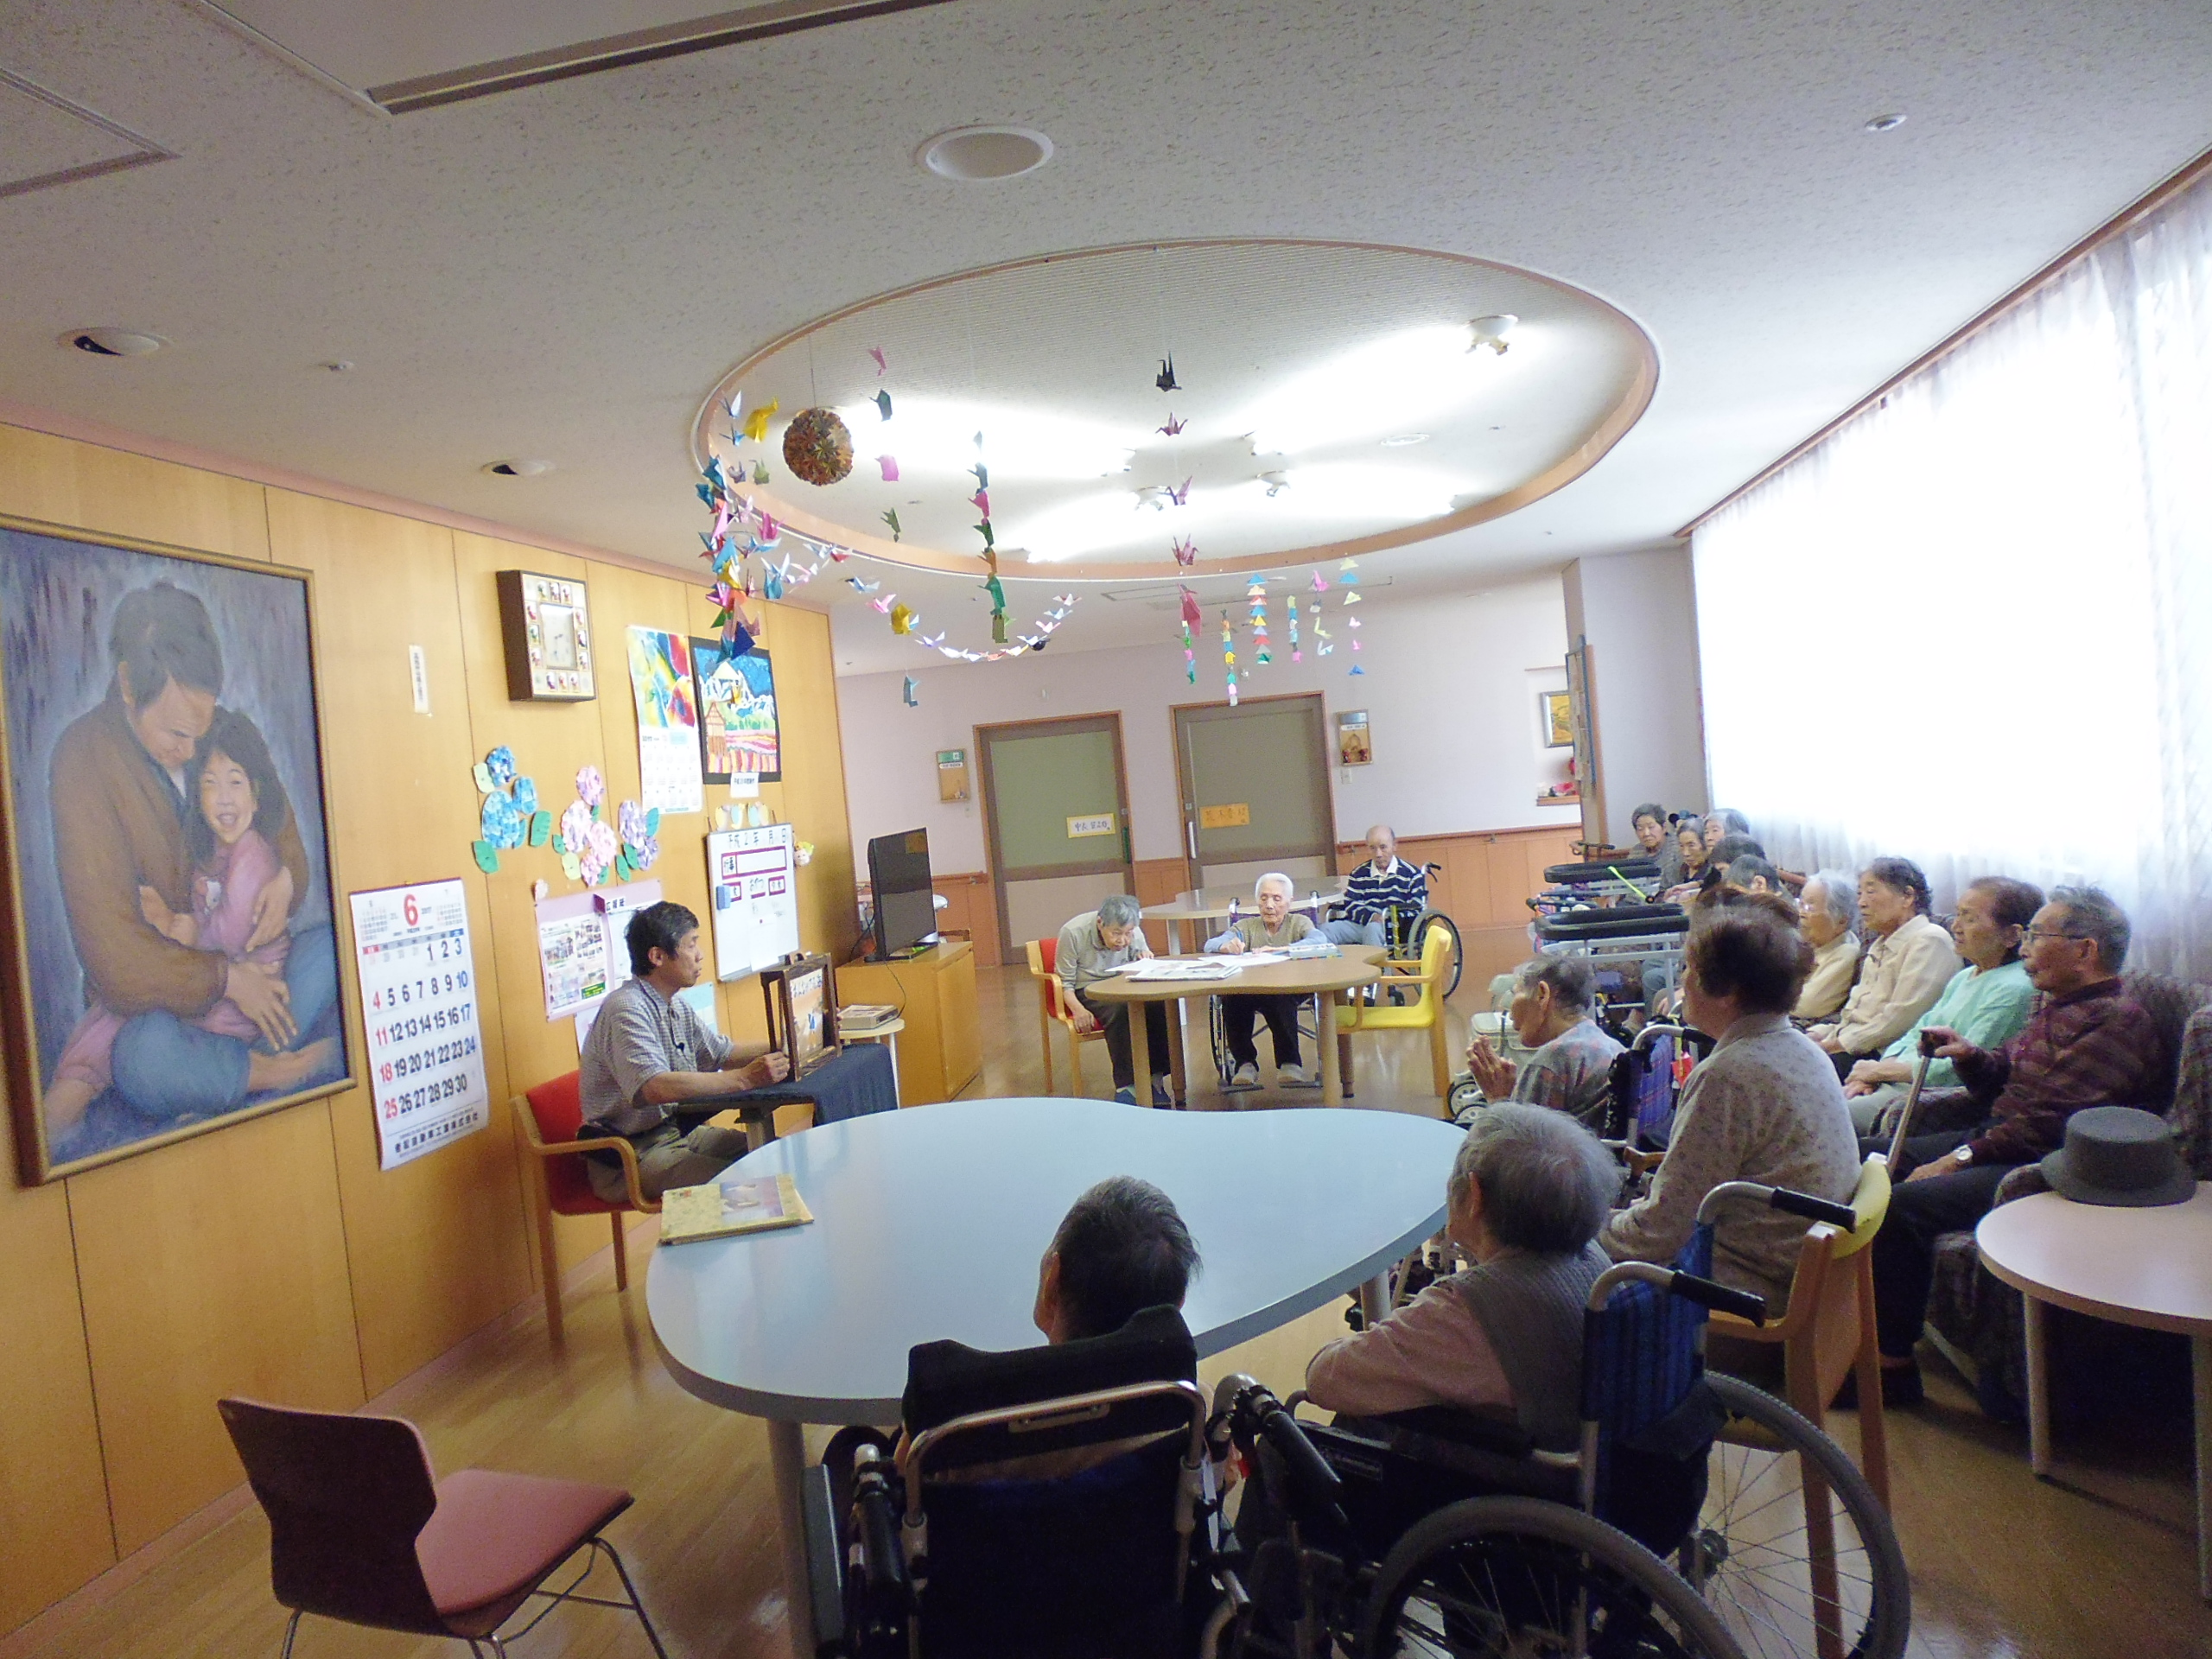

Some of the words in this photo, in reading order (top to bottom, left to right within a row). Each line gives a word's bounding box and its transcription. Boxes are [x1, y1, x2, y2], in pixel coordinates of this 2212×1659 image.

[404, 893, 419, 926] 6
[427, 943, 434, 961] 1
[441, 940, 449, 958] 2
[454, 938, 462, 955] 3
[373, 991, 380, 1009] 4
[387, 988, 396, 1007] 5
[402, 984, 410, 1002] 6
[416, 980, 423, 999] 7
[430, 977, 439, 995] 8
[444, 974, 453, 992] 9
[456, 970, 467, 988] 10
[375, 1027, 388, 1046] 11
[389, 1022, 404, 1042] 12
[404, 1019, 417, 1038] 13
[419, 1014, 431, 1033] 14
[434, 1010, 446, 1029] 15
[448, 1007, 459, 1026] 16
[461, 1003, 471, 1021] 17
[379, 1062, 393, 1083] 18
[394, 1058, 407, 1077] 19
[409, 1052, 422, 1073] 20
[424, 1048, 435, 1068] 21
[437, 1044, 450, 1064] 22
[451, 1039, 463, 1059] 23
[464, 1035, 476, 1055] 24
[384, 1097, 398, 1119] 25
[398, 1093, 413, 1114] 26
[413, 1088, 425, 1108] 27
[428, 1083, 441, 1103] 28
[442, 1078, 454, 1098] 29
[454, 1073, 467, 1093] 30
